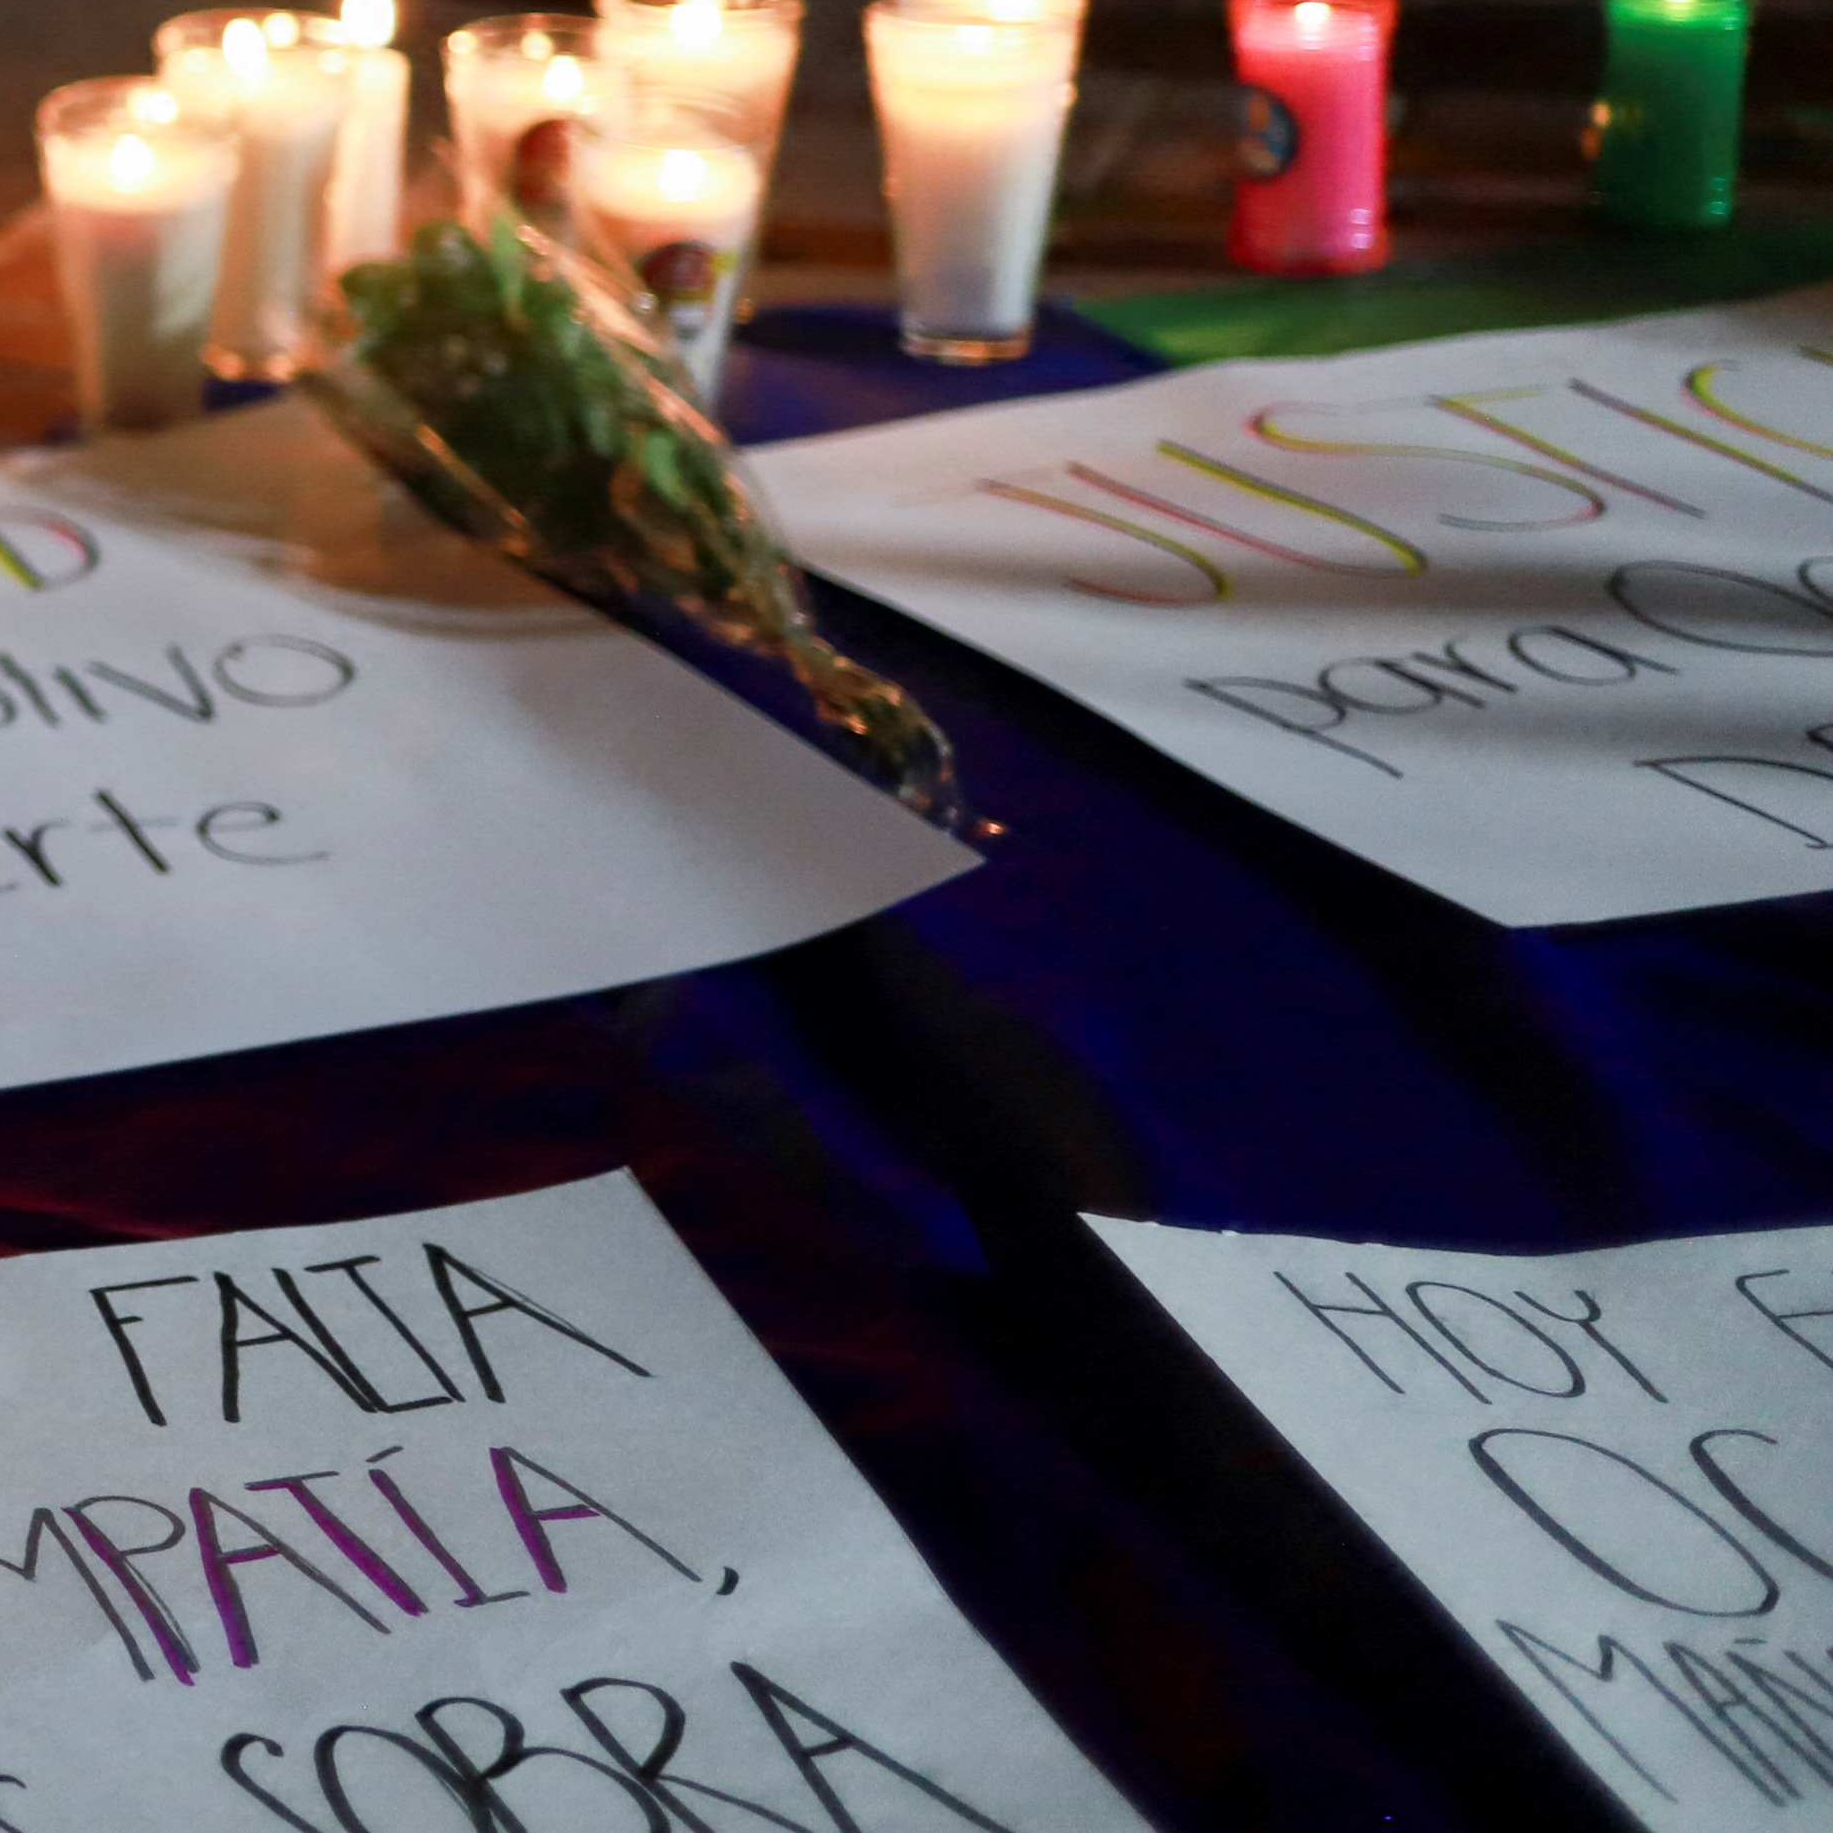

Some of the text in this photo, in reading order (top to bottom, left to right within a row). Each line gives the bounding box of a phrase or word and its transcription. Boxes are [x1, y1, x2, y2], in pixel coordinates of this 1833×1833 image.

[895, 342, 1833, 604] JUSTIC
[1185, 621, 1681, 779] para
[90, 1242, 652, 1428] FALTA
[1273, 1271, 1669, 1405] HOY
